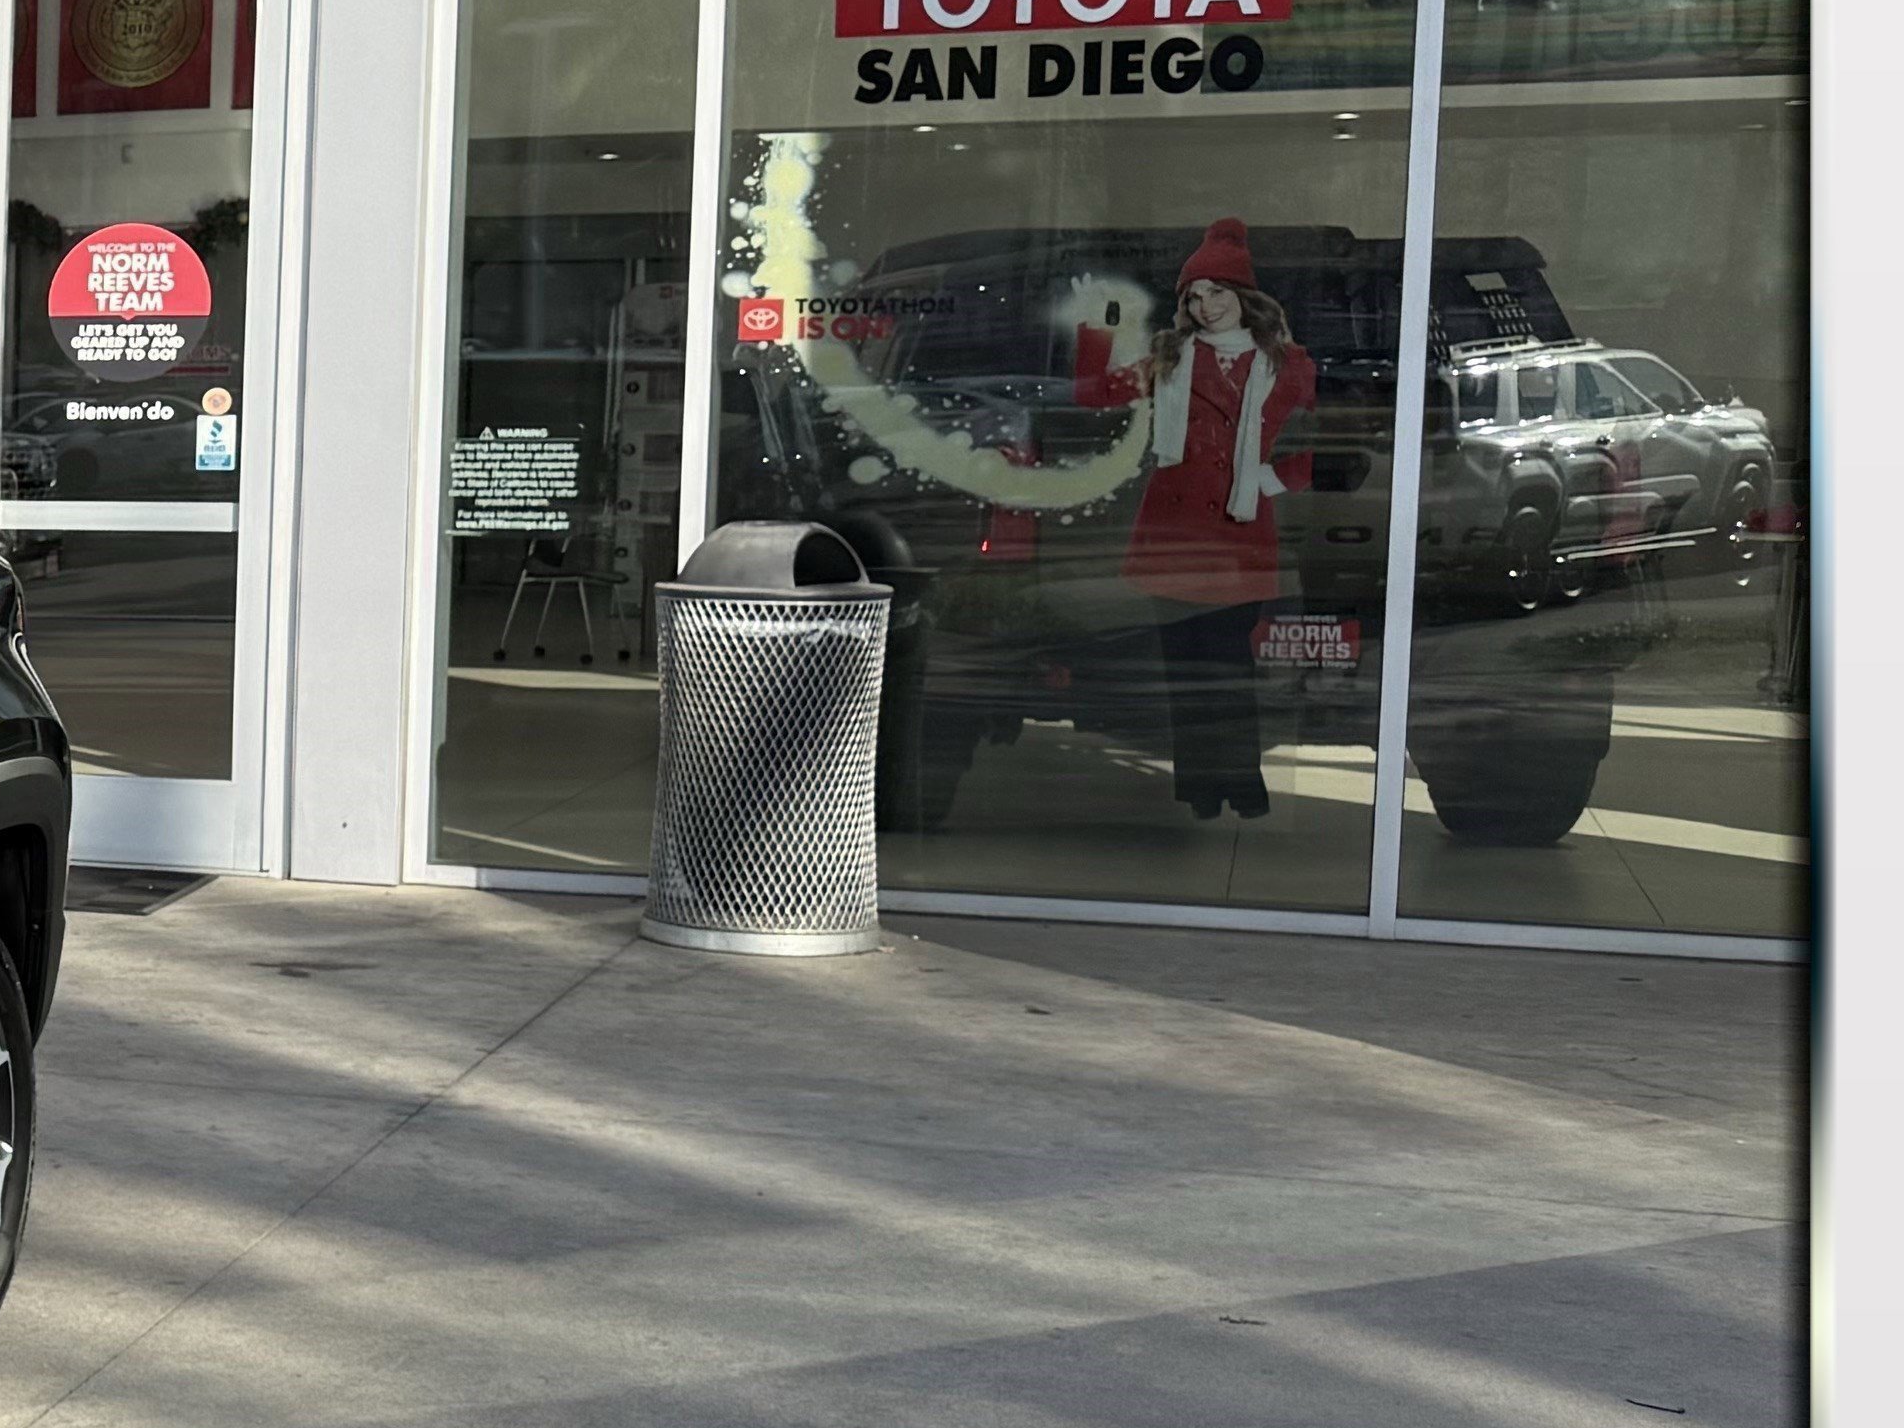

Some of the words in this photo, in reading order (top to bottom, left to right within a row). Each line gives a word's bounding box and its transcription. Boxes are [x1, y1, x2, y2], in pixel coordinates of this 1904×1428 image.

[854, 44, 997, 103] SAN
[1028, 34, 1264, 98] DIEGO
[88, 243, 137, 253] WELCOME
[140, 242, 154, 252] TO
[92, 253, 169, 272] NORM
[88, 272, 174, 292] REEVES
[95, 292, 163, 312] TEAM
[795, 297, 956, 314] TOYOTATHON
[116, 324, 144, 336] GET
[146, 324, 177, 336] YOU
[798, 317, 825, 340] IS
[129, 337, 150, 348] UP
[151, 336, 185, 348] AND
[77, 349, 123, 361] READY
[125, 349, 146, 361] TO
[148, 349, 177, 361] GO!
[66, 401, 175, 420] Bienvendo
[1269, 624, 1342, 641] NORM
[1260, 642, 1351, 659] REEVES
